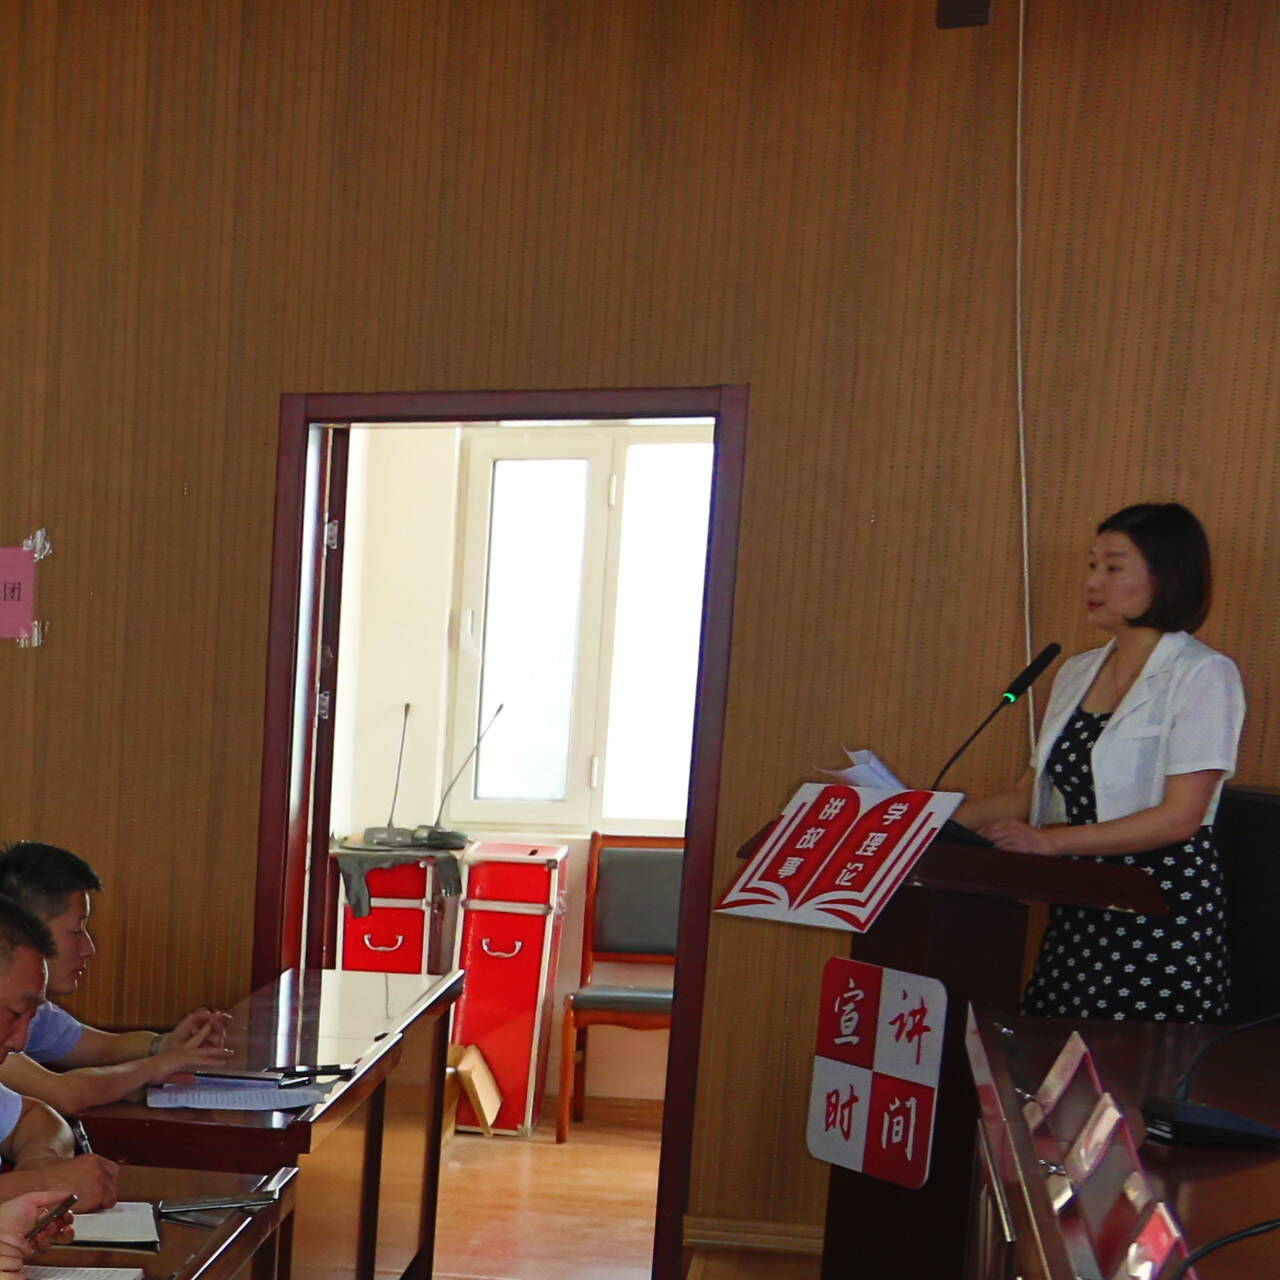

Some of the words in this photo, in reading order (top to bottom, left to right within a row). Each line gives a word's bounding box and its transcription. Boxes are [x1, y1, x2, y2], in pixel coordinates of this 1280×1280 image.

[777, 797, 846, 879] 讲故事
[835, 802, 910, 887] 学理论
[833, 978, 932, 1065] 宣讲
[824, 1083, 919, 1162] 时间
